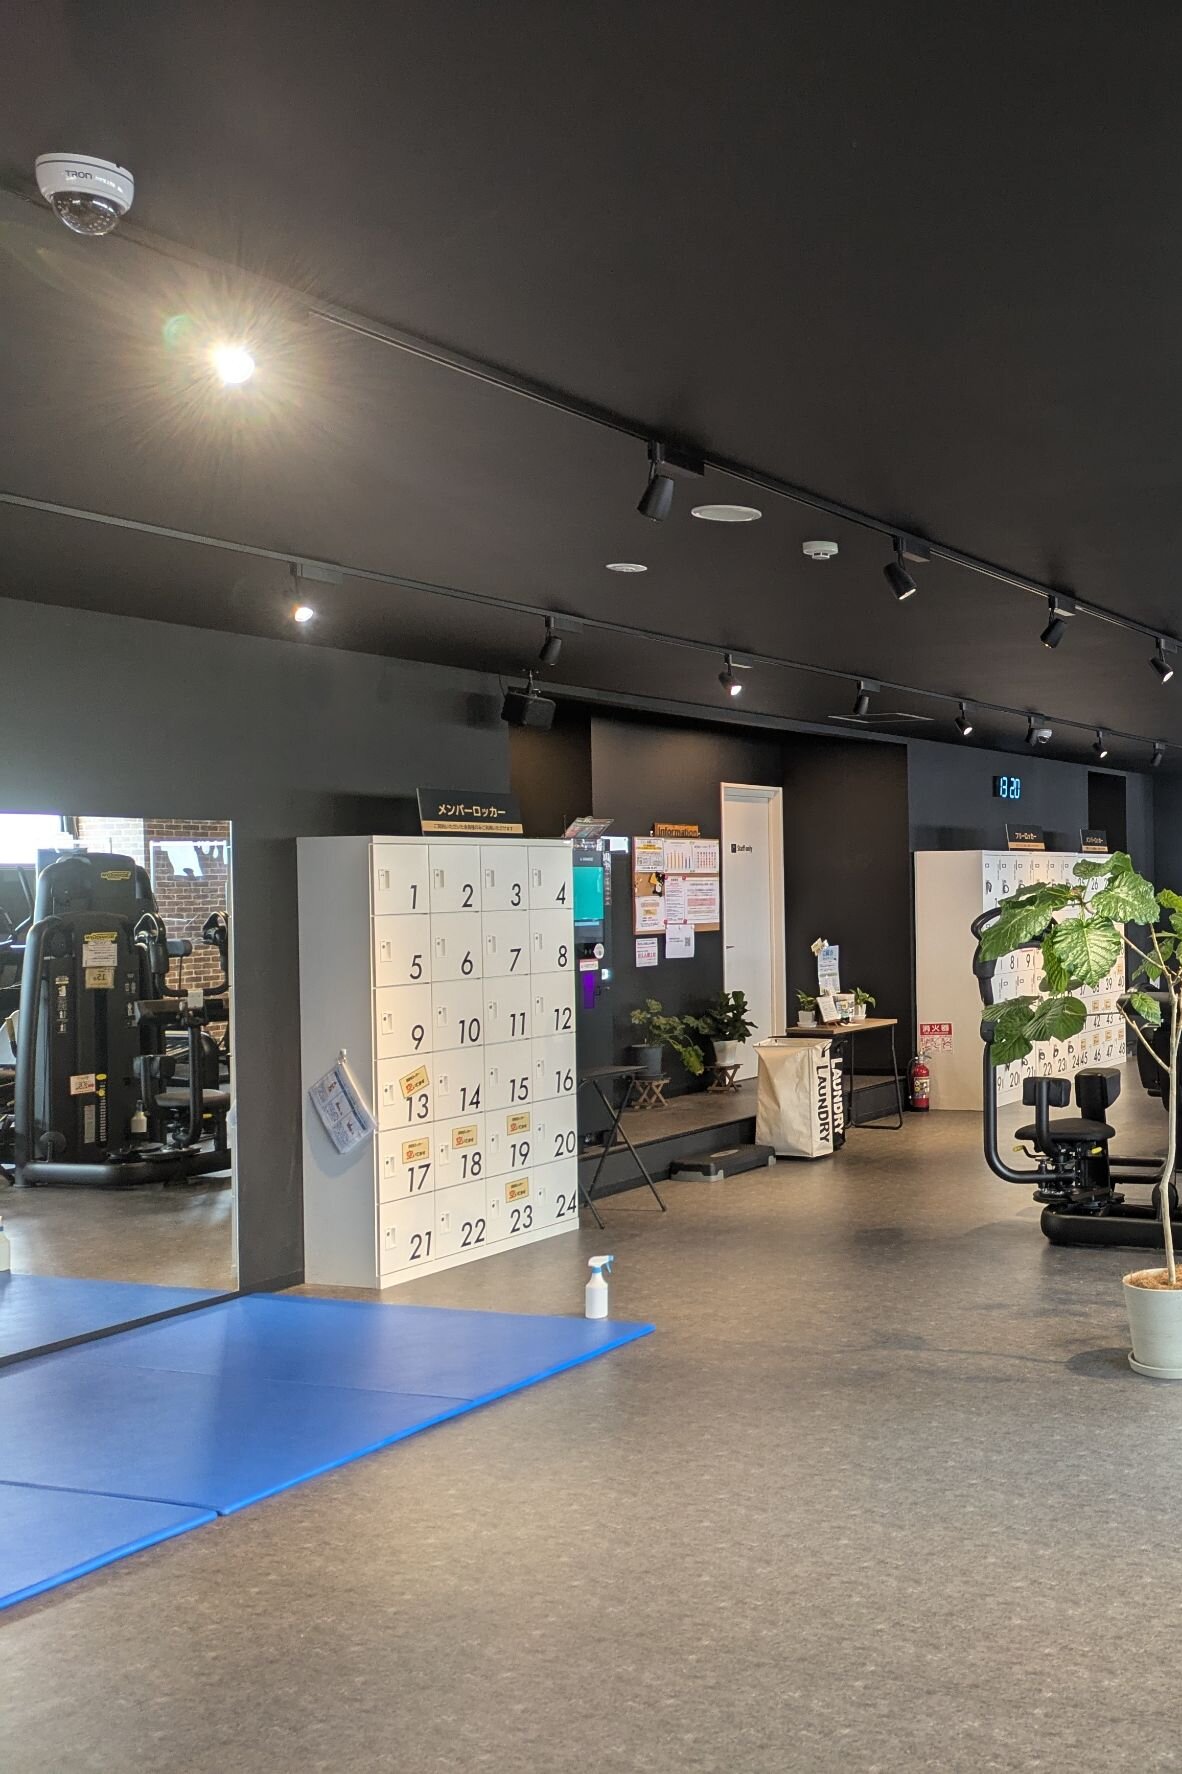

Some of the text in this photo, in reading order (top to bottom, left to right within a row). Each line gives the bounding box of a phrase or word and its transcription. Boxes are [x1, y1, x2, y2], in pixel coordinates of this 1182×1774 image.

[64, 169, 93, 180] TRON
[438, 804, 506, 818] メンバーロッカー
[658, 826, 698, 837] Information
[411, 885, 417, 909] 1
[462, 884, 474, 907] 2
[511, 884, 521, 906] 3
[556, 882, 566, 905] 4
[410, 955, 422, 979] 5
[461, 951, 473, 976] 6
[510, 948, 522, 972] 7
[558, 945, 568, 967] 8
[459, 1018, 480, 1043] 10
[510, 1013, 526, 1036] 11
[554, 1008, 572, 1030] 12
[922, 1024, 950, 1032] 消火器
[411, 1025, 424, 1050] 9
[509, 1077, 529, 1102] 15
[555, 1069, 574, 1093] 16
[406, 1094, 429, 1121] 13
[460, 1084, 481, 1112] 14
[816, 1064, 830, 1143] LAUNDRY
[830, 1057, 844, 1135] LAUNDRY
[510, 1141, 530, 1167] 19
[554, 1131, 576, 1157] 20
[461, 1151, 482, 1178] 18
[408, 1163, 431, 1192] 17
[556, 1189, 577, 1218] 24
[510, 1205, 533, 1233] 23
[410, 1231, 432, 1260] 21
[461, 1219, 486, 1248] 22
